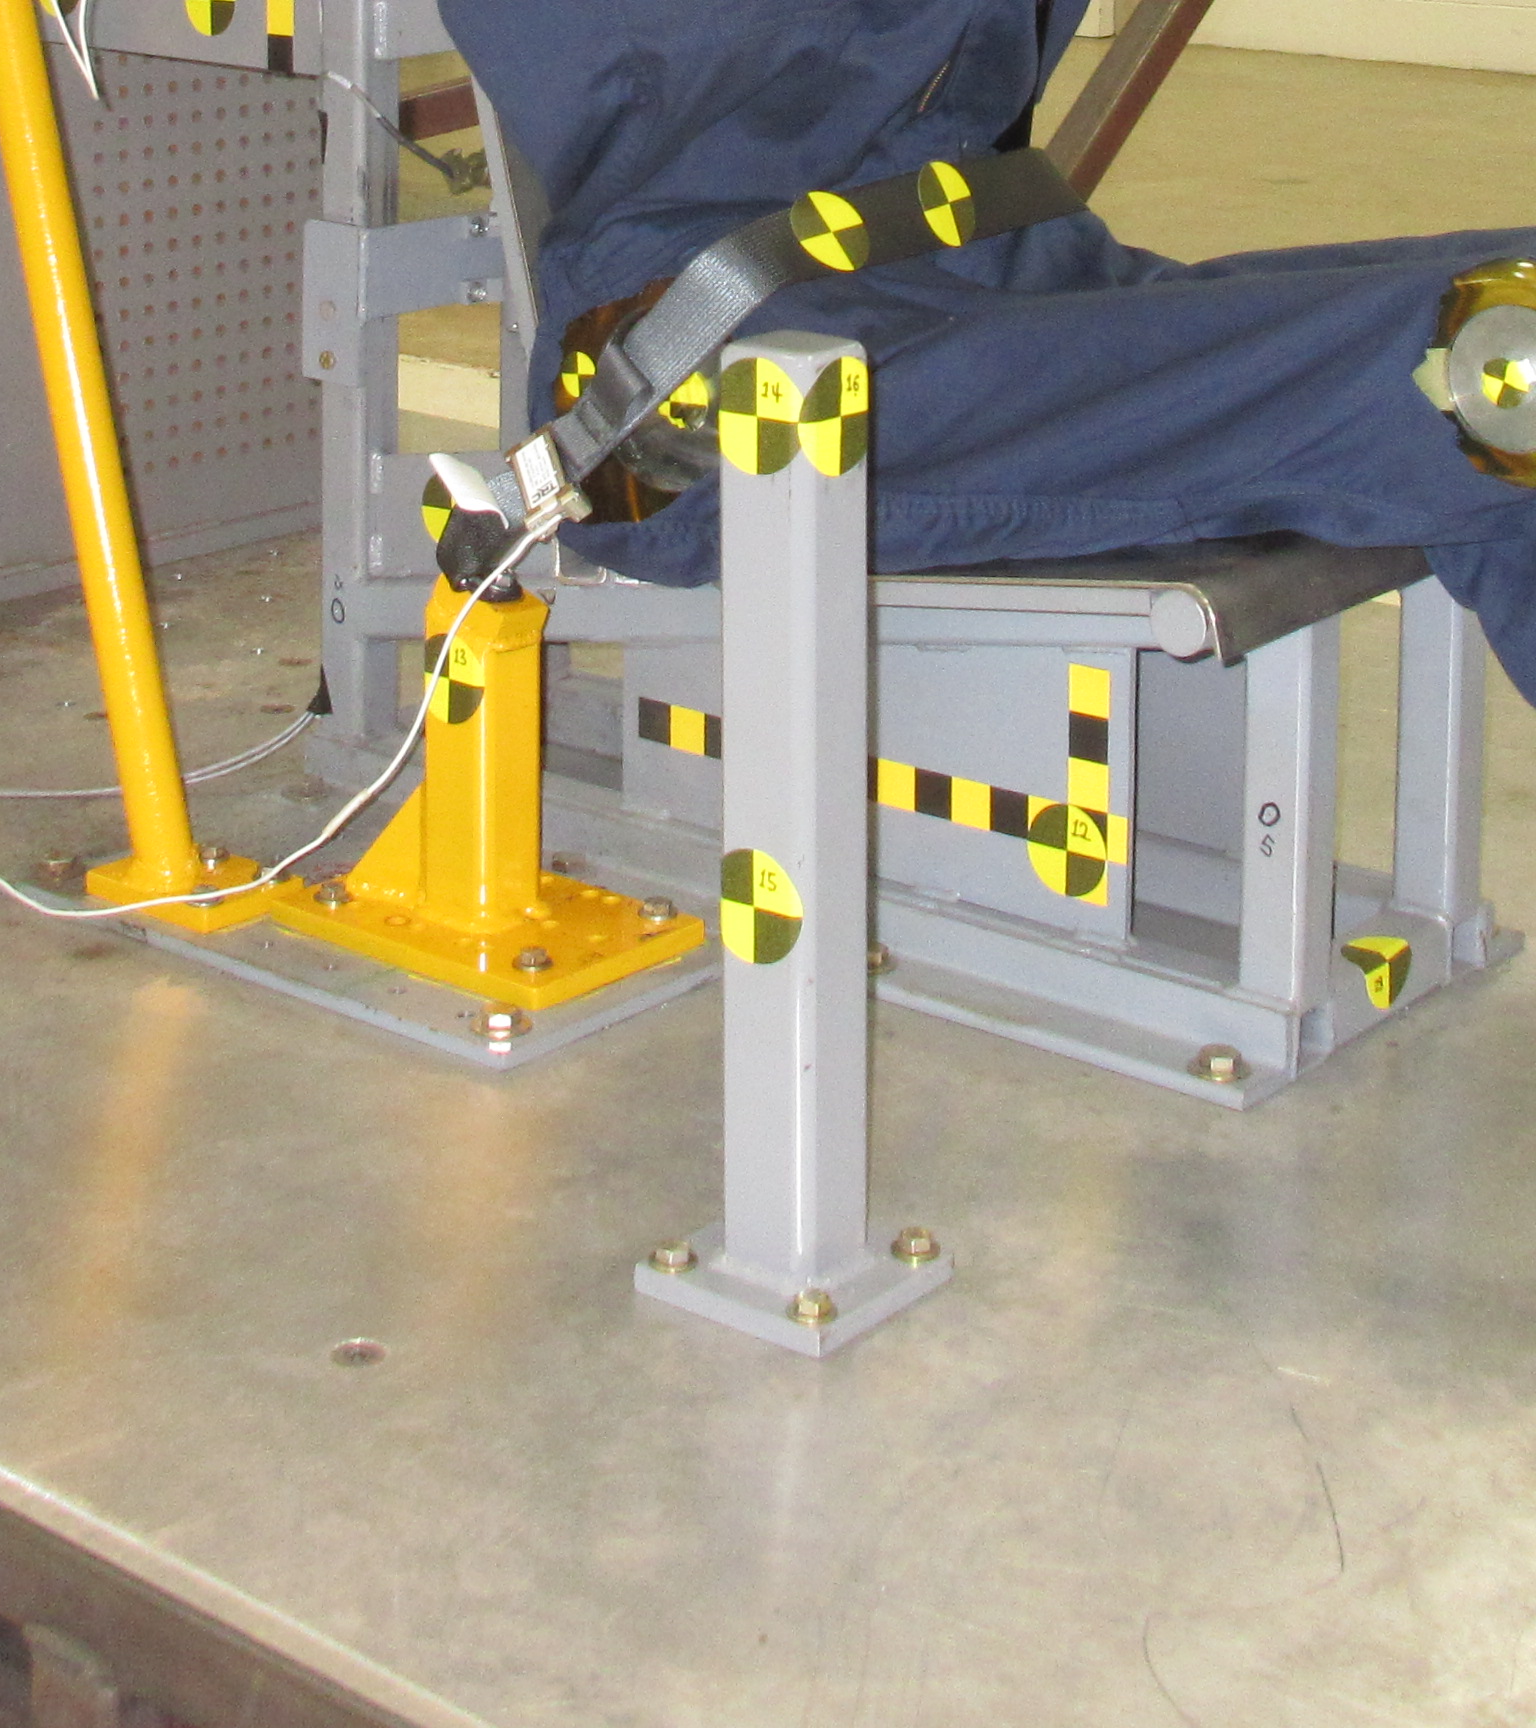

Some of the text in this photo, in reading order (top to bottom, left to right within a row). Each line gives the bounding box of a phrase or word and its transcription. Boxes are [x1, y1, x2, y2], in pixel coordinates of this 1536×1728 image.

[761, 381, 783, 404] 14
[454, 646, 468, 667] 13
[1070, 819, 1093, 843] 12
[758, 870, 779, 892] 15
